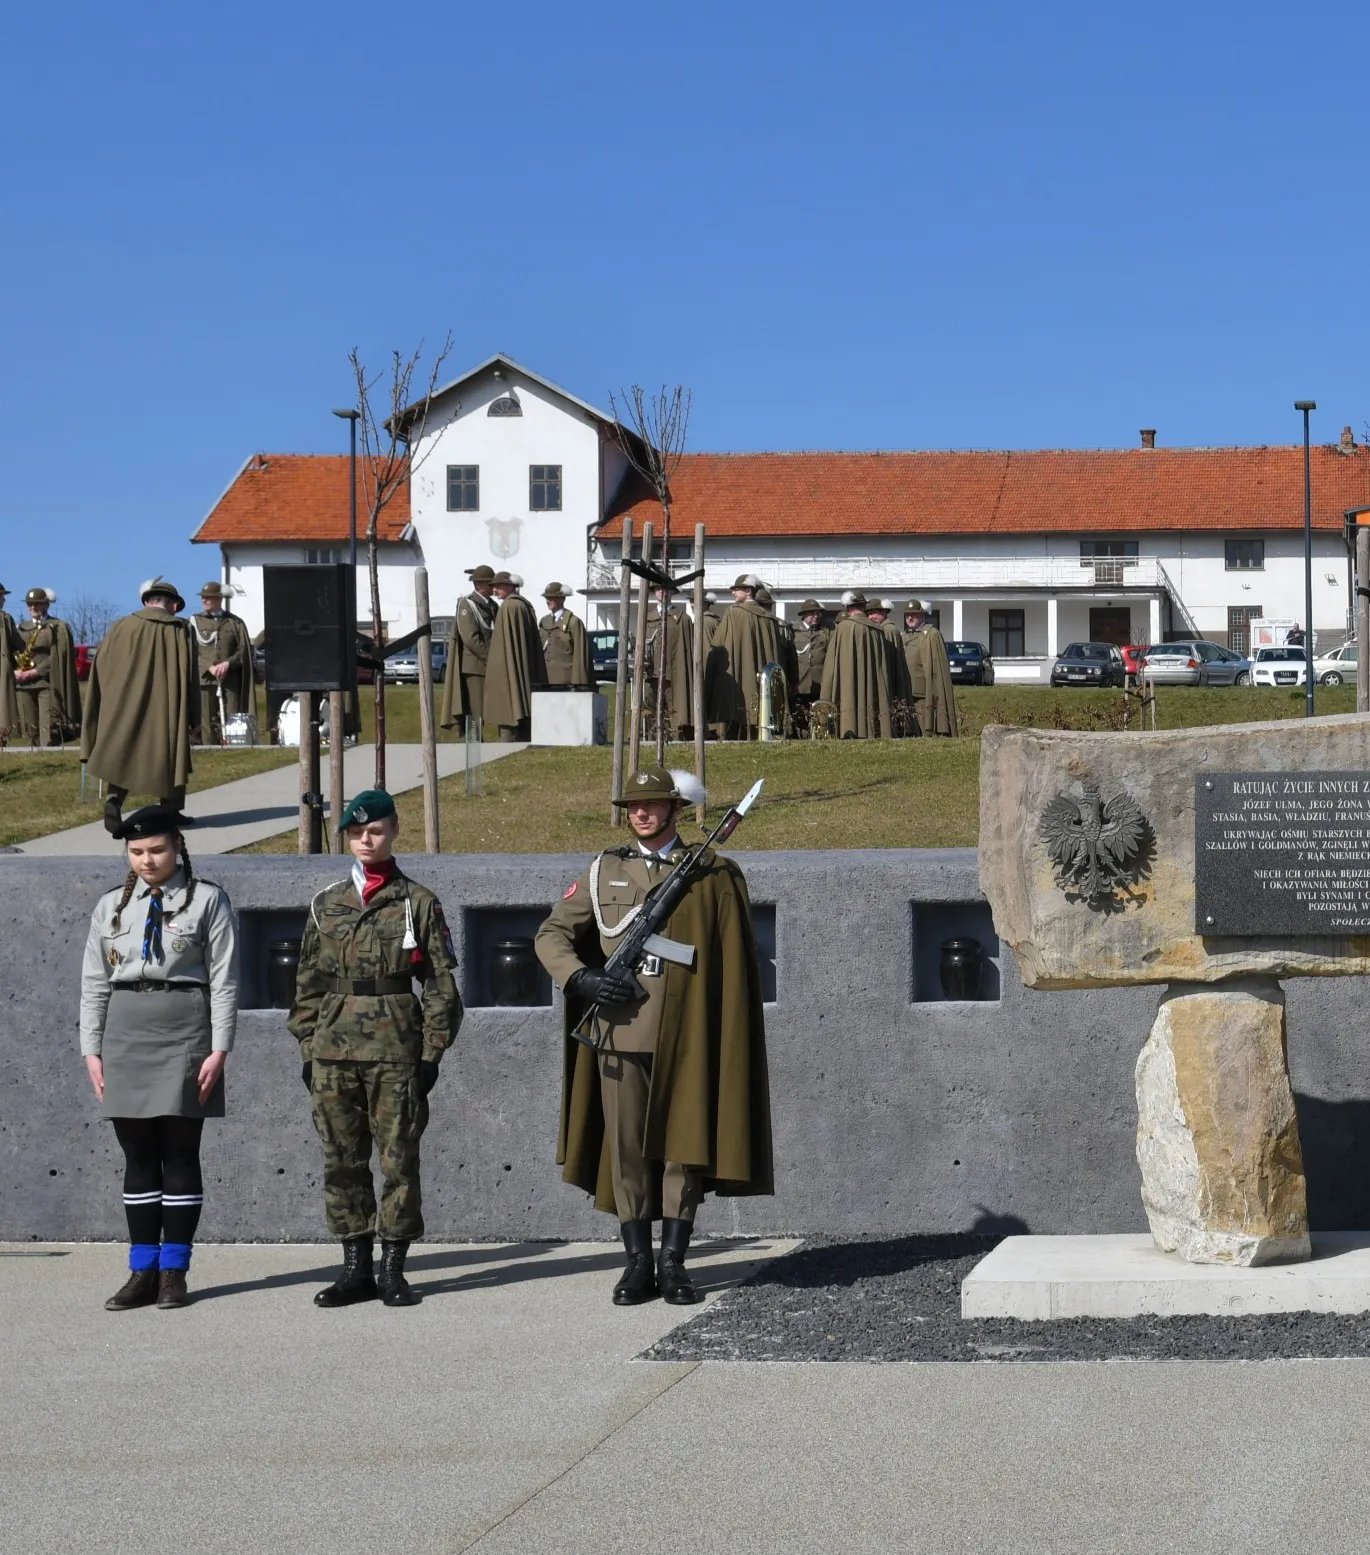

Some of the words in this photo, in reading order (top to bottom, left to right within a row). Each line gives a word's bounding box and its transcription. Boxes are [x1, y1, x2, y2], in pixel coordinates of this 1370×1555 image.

[1233, 781, 1279, 795] RATUJĄC
[1283, 778, 1315, 793] ŻYCIE
[1319, 781, 1358, 793] INNYCH
[1242, 798, 1271, 809] JÓZEF
[1275, 800, 1305, 810] ULMA,
[1308, 800, 1333, 809] JEGO
[1337, 797, 1363, 808] ŻONA
[1212, 812, 1247, 823] STASIA,
[1251, 812, 1281, 823] BASIA,
[1284, 812, 1331, 822] WŁADZIU,
[1223, 830, 1277, 841] UKRYWAJĄC
[1280, 827, 1309, 839] OŚMIU
[1312, 829, 1363, 838] STARSZYCH
[1205, 839, 1248, 849] SZALLÓW
[1322, 841, 1358, 851] ZGINĘLI
[1297, 852, 1304, 860] Z
[1307, 852, 1326, 862] RĄK
[1254, 869, 1281, 878] NIECH
[1285, 869, 1300, 878] ICH
[1304, 869, 1337, 878] OFIARA
[1270, 881, 1328, 889] OKAZYWANIA
[1331, 878, 1369, 888] MIŁOŚCI
[1296, 891, 1317, 900] BYLI
[1320, 891, 1354, 900] SYNAMI
[1308, 902, 1357, 913] POZOSTAJĄ
[1361, 902, 1369, 910] W
